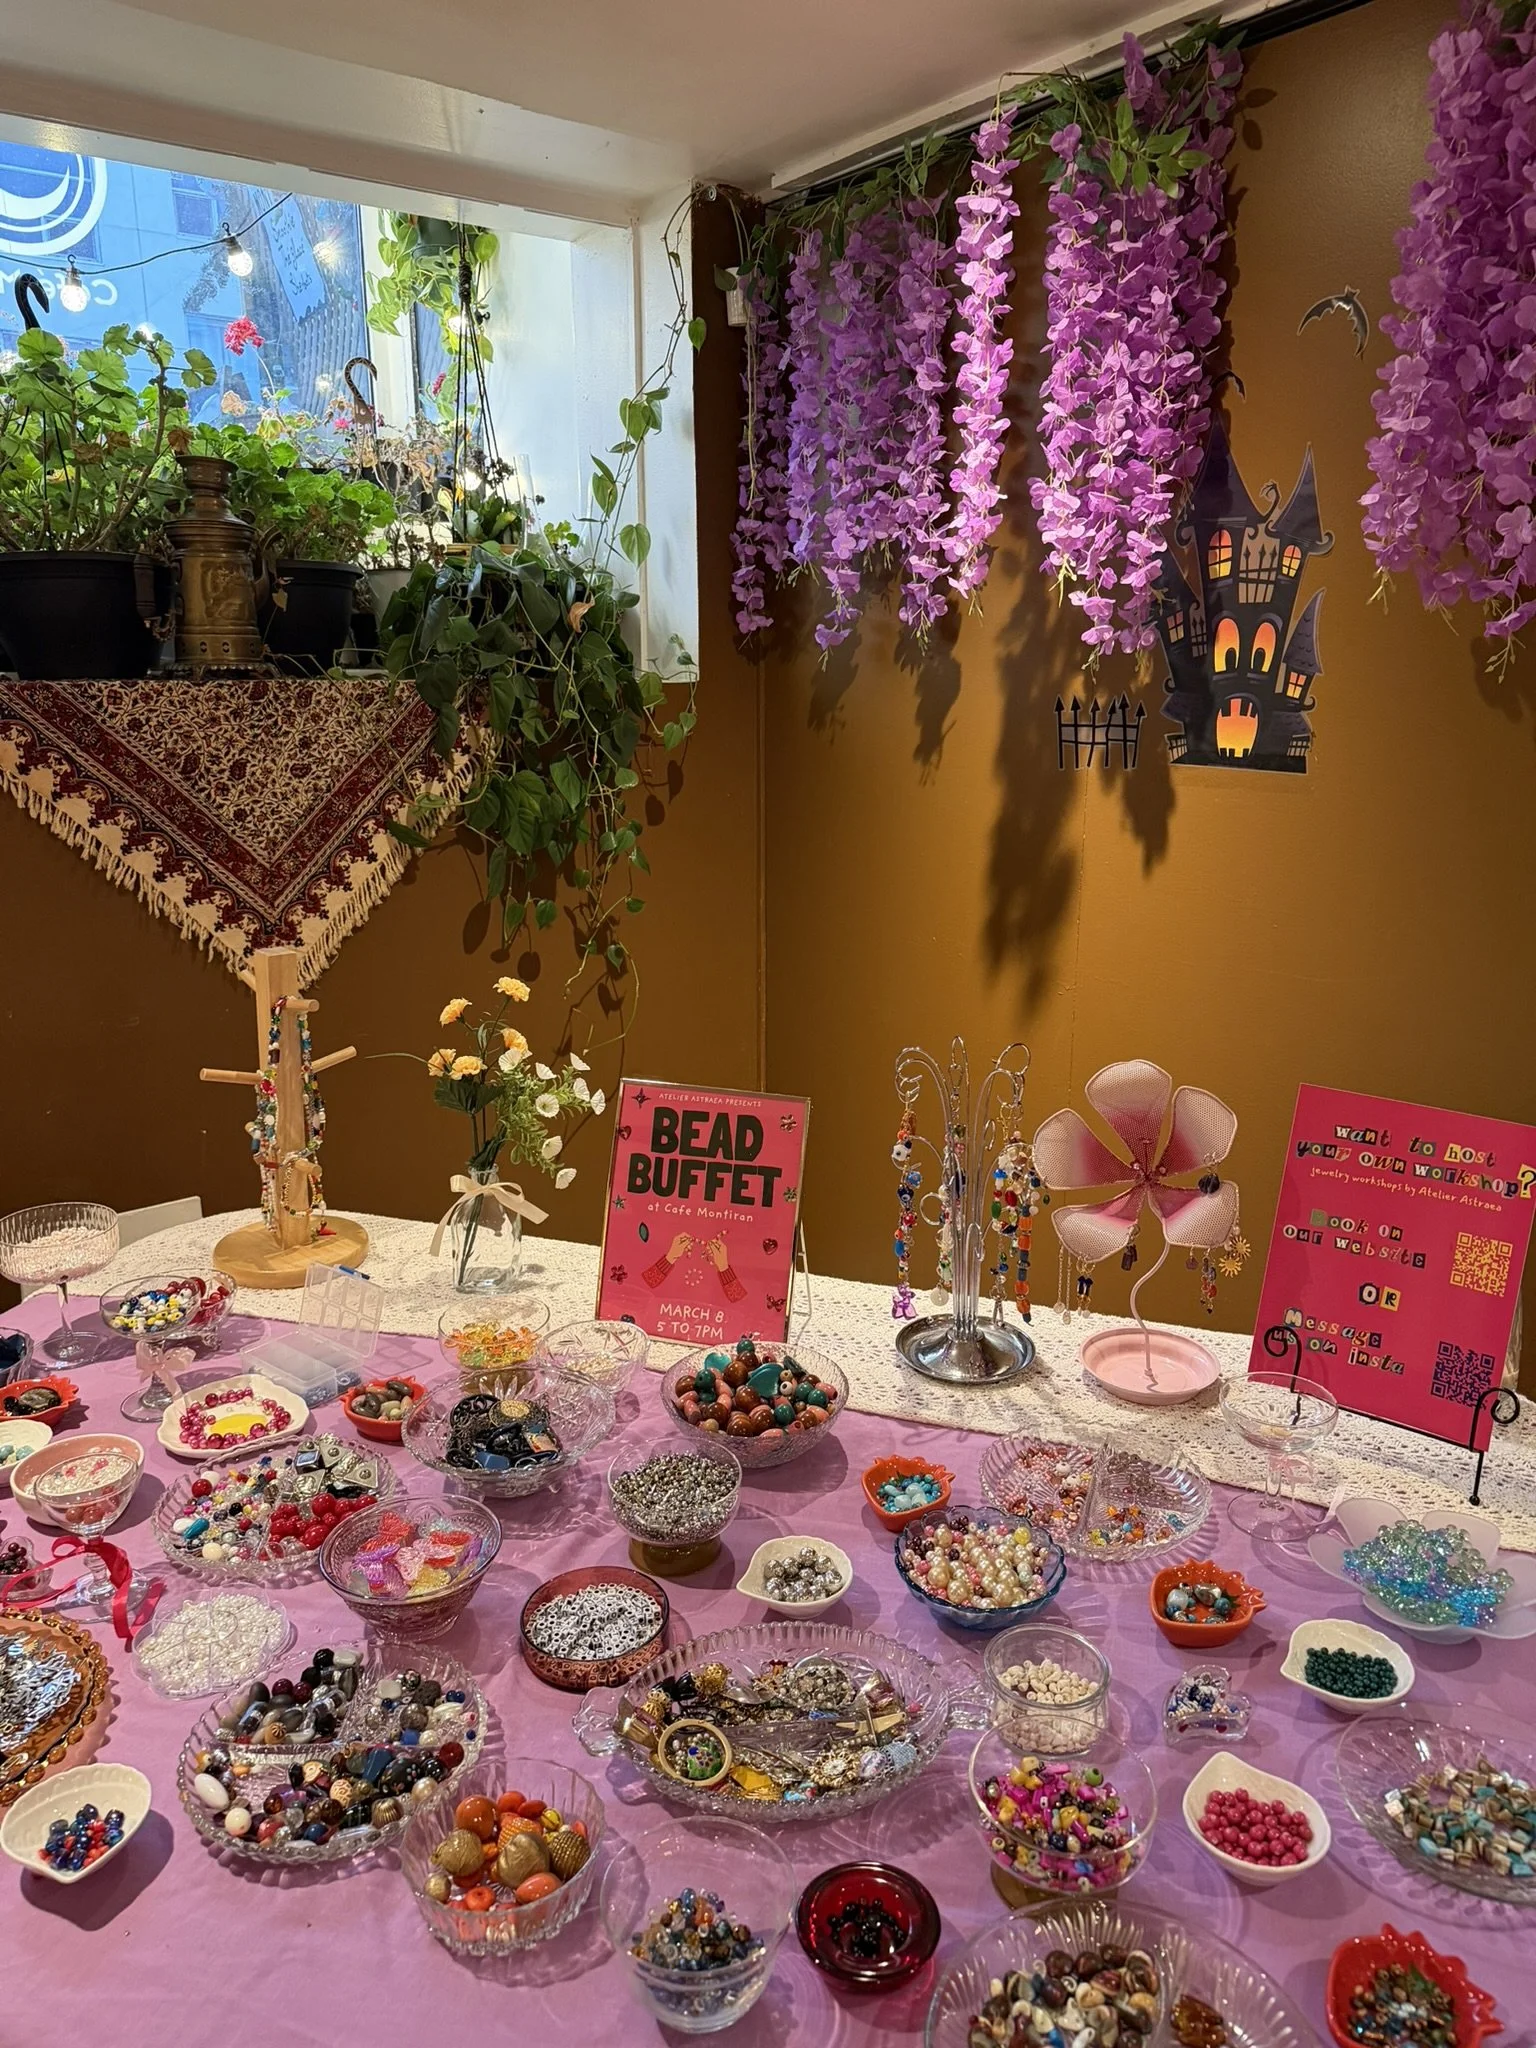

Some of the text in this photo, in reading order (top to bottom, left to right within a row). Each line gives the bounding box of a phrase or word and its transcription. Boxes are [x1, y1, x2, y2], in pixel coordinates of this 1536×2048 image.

[658, 1092, 762, 1108] ATELIER ASTRAEA PRESENTS
[651, 1106, 764, 1162] BEAD
[1335, 1125, 1496, 1168] want to host
[1297, 1141, 1352, 1162] your
[627, 1153, 783, 1208] BUFFET
[1310, 1167, 1503, 1212] jewelry workshops by Atelier Astraea
[647, 1201, 753, 1222] at Cafe Montiran
[1334, 1236, 1427, 1269] website
[1359, 1282, 1401, 1312] OR
[660, 1303, 724, 1323] MARCH 8
[1284, 1307, 1382, 1348] Message
[656, 1321, 723, 1340] 5 TO 7PM
[1307, 1337, 1338, 1355] on
